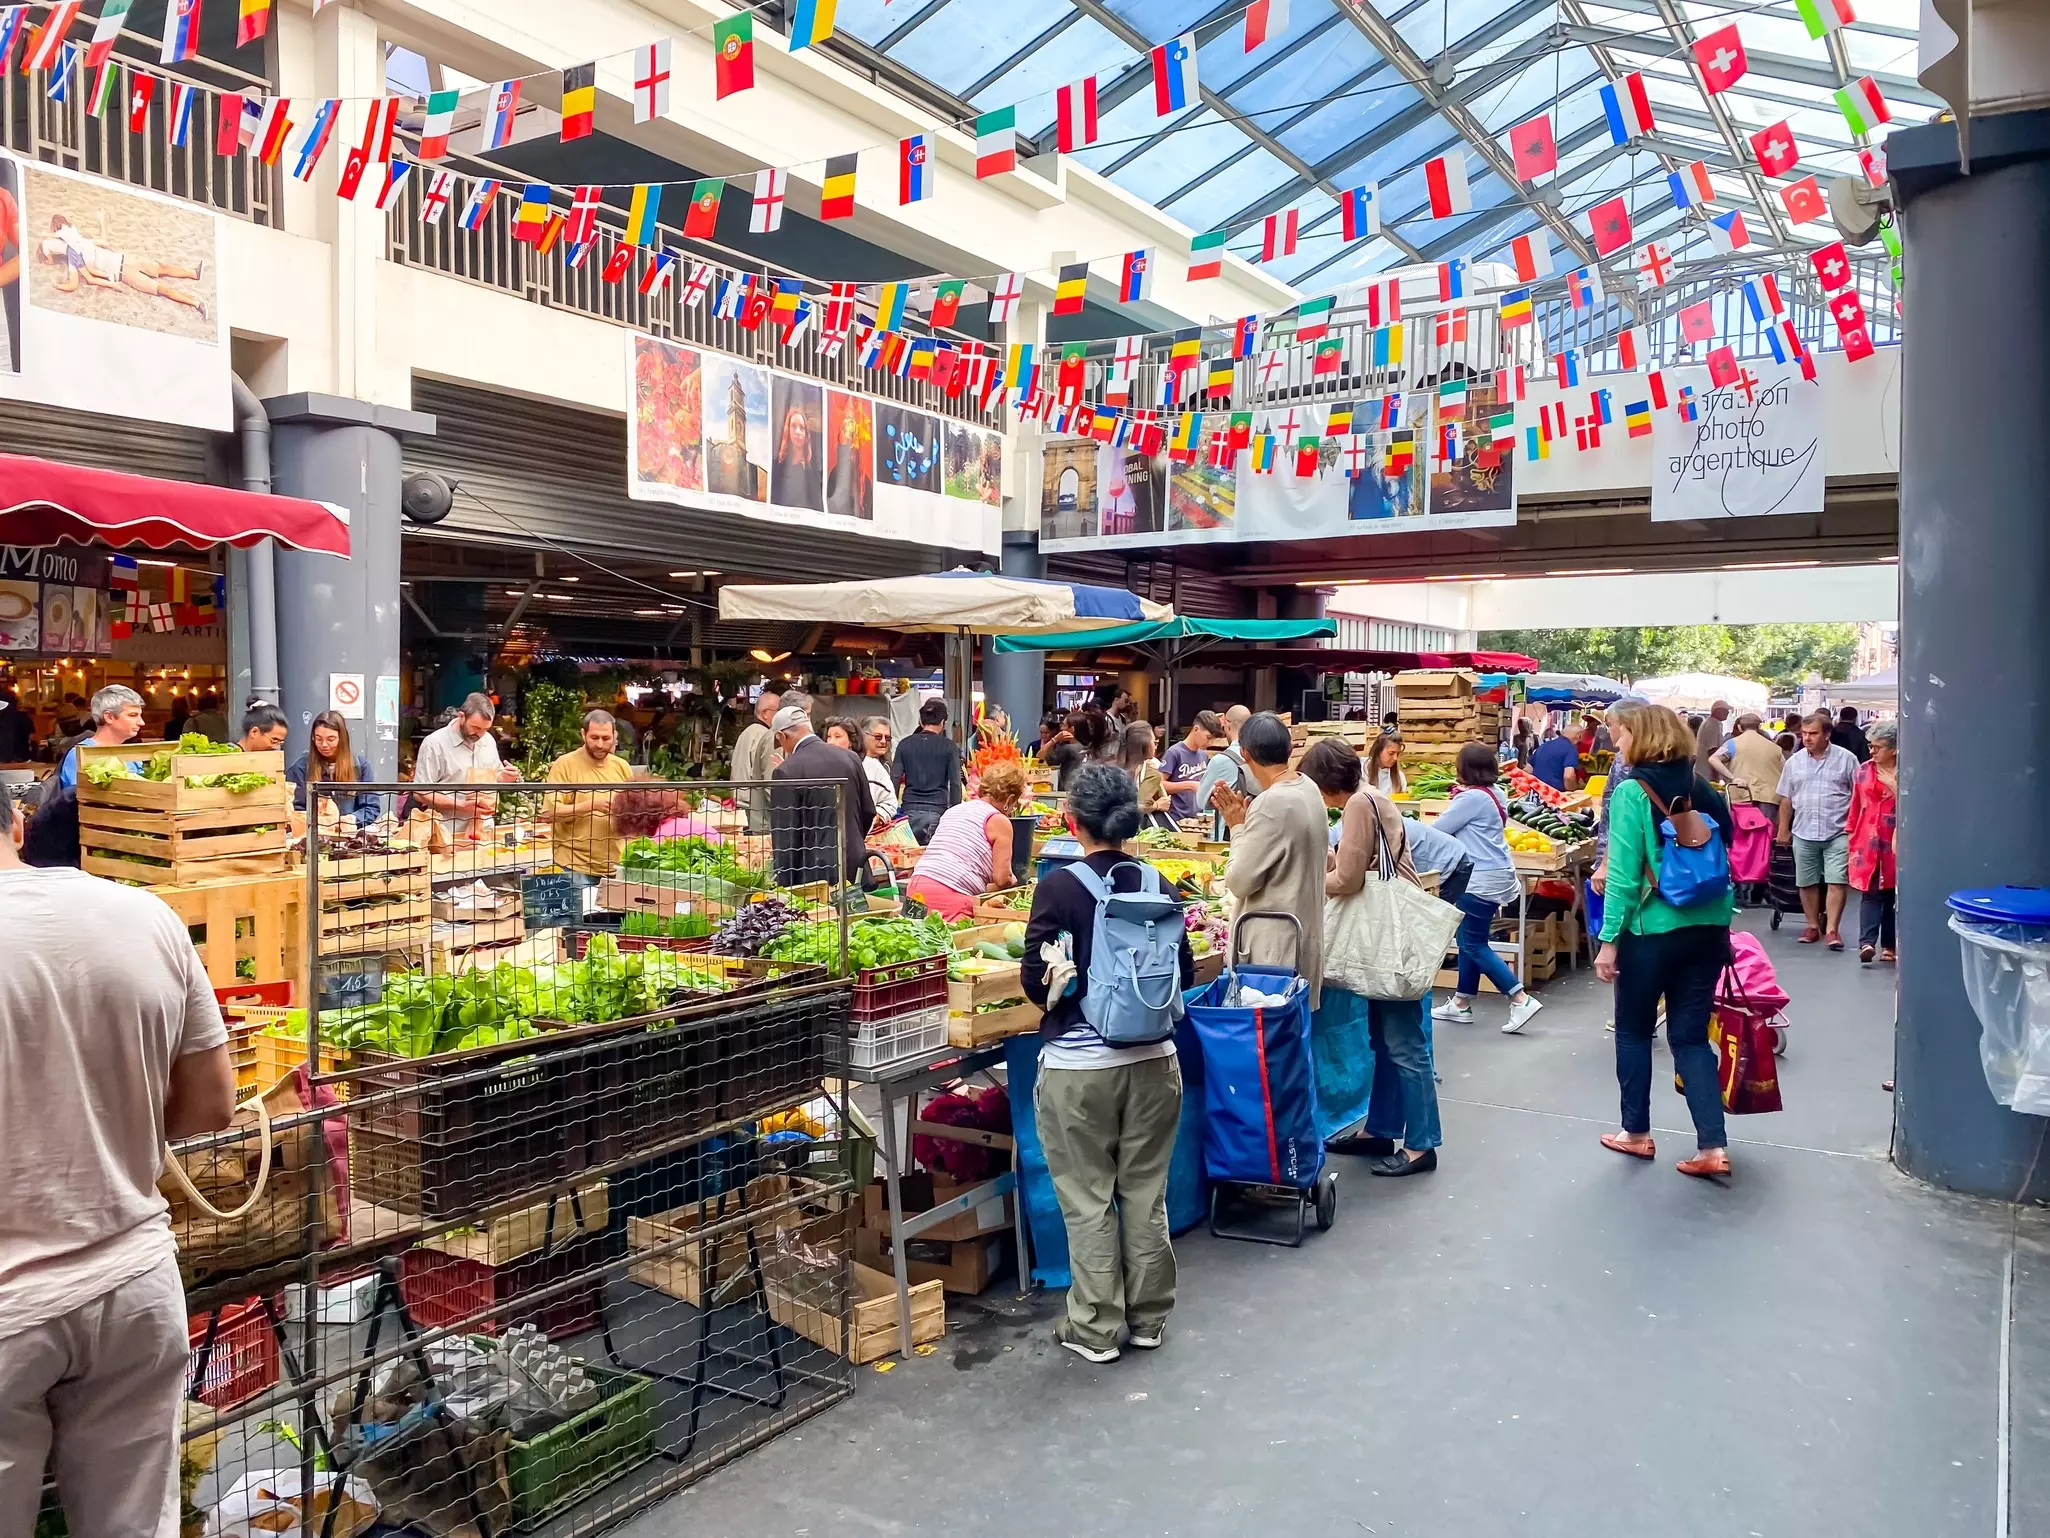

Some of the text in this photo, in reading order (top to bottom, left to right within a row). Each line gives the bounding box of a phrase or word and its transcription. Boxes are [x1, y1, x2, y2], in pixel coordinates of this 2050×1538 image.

[1697, 416, 1765, 450] photo
[1668, 445, 1796, 480] argentique
[1288, 1136, 1298, 1171] ROLSER
